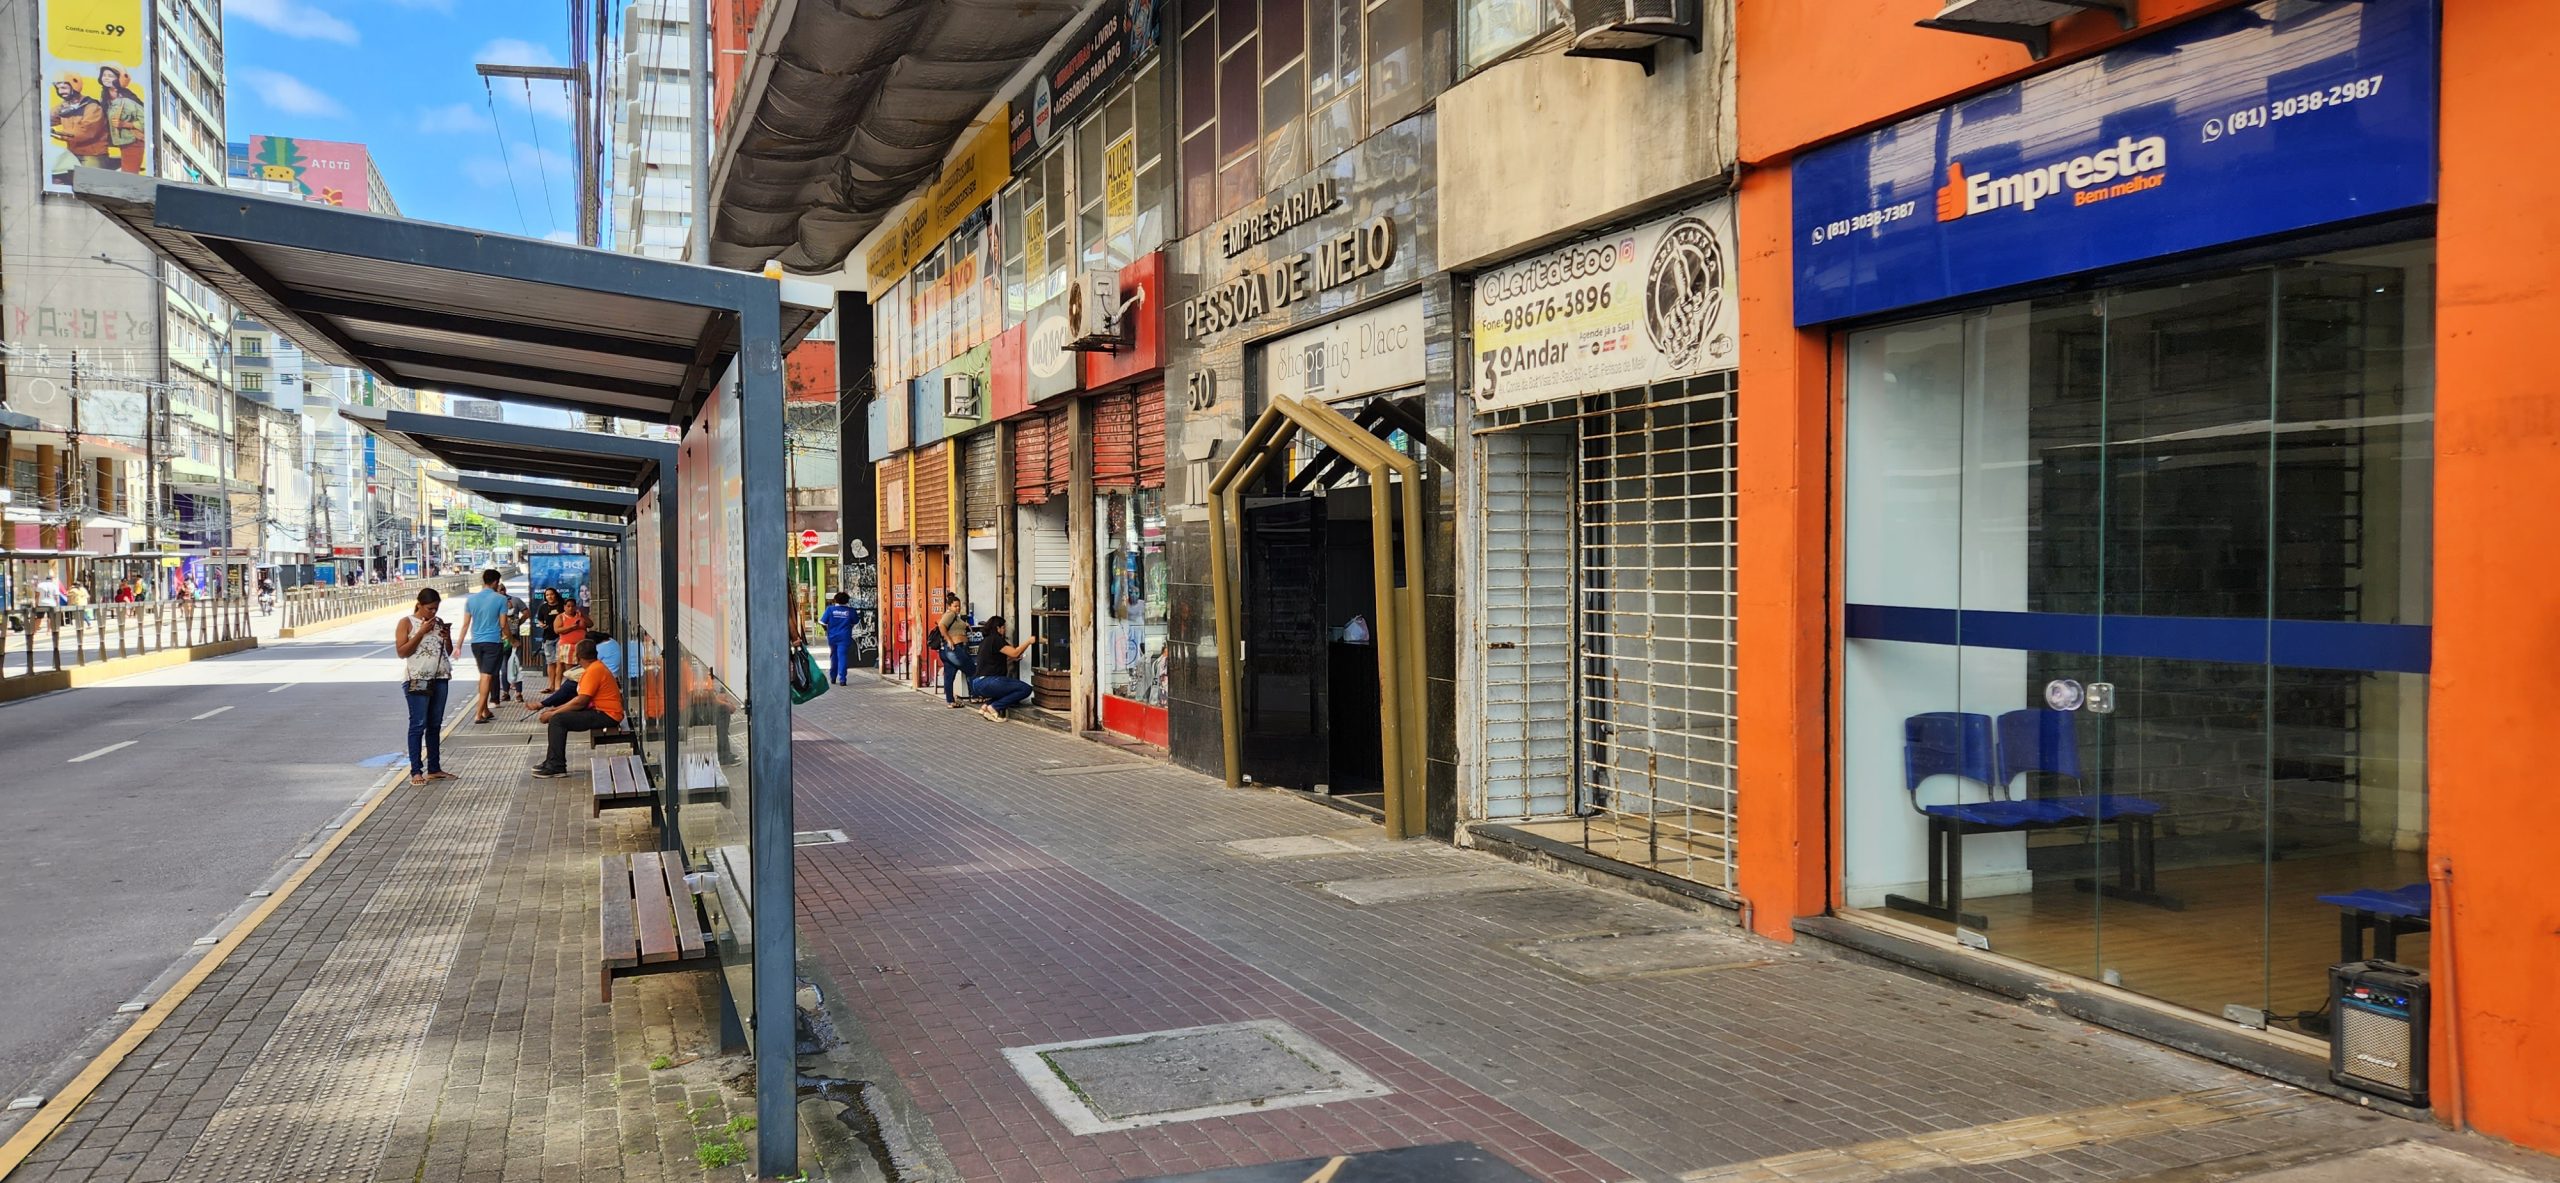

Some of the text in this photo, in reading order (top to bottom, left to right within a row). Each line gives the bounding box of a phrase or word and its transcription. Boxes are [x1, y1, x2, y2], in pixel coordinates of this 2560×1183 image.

[65, 25, 84, 33] Conta
[105, 23, 126, 37] 99
[1094, 15, 1118, 51] LIVROS
[1055, 70, 1090, 116] ACESSÓRIOS
[1090, 55, 1107, 84] PARA
[1107, 40, 1121, 68] RPG
[2227, 74, 2384, 136] (81) 3038-2987
[1108, 139, 1133, 186] ALUGO
[1966, 136, 2167, 212] Empresta
[2073, 173, 2166, 208] Bem melhor
[1027, 208, 1044, 242] ALUGO
[1221, 178, 1338, 258] EMPRESARIAL
[1826, 201, 1916, 241] (81) 3038-7387
[1184, 216, 1395, 340] PESSOA DE MELO
[1483, 244, 1617, 306] @Leritattoo
[1482, 282, 1612, 333] Fone: 98676-3896
[1277, 317, 1408, 389] Shopping Place
[1513, 339, 1569, 372] Andar
[1579, 328, 1603, 342] Agende
[1618, 322, 1629, 332] Sua
[1187, 367, 1214, 411] 50
